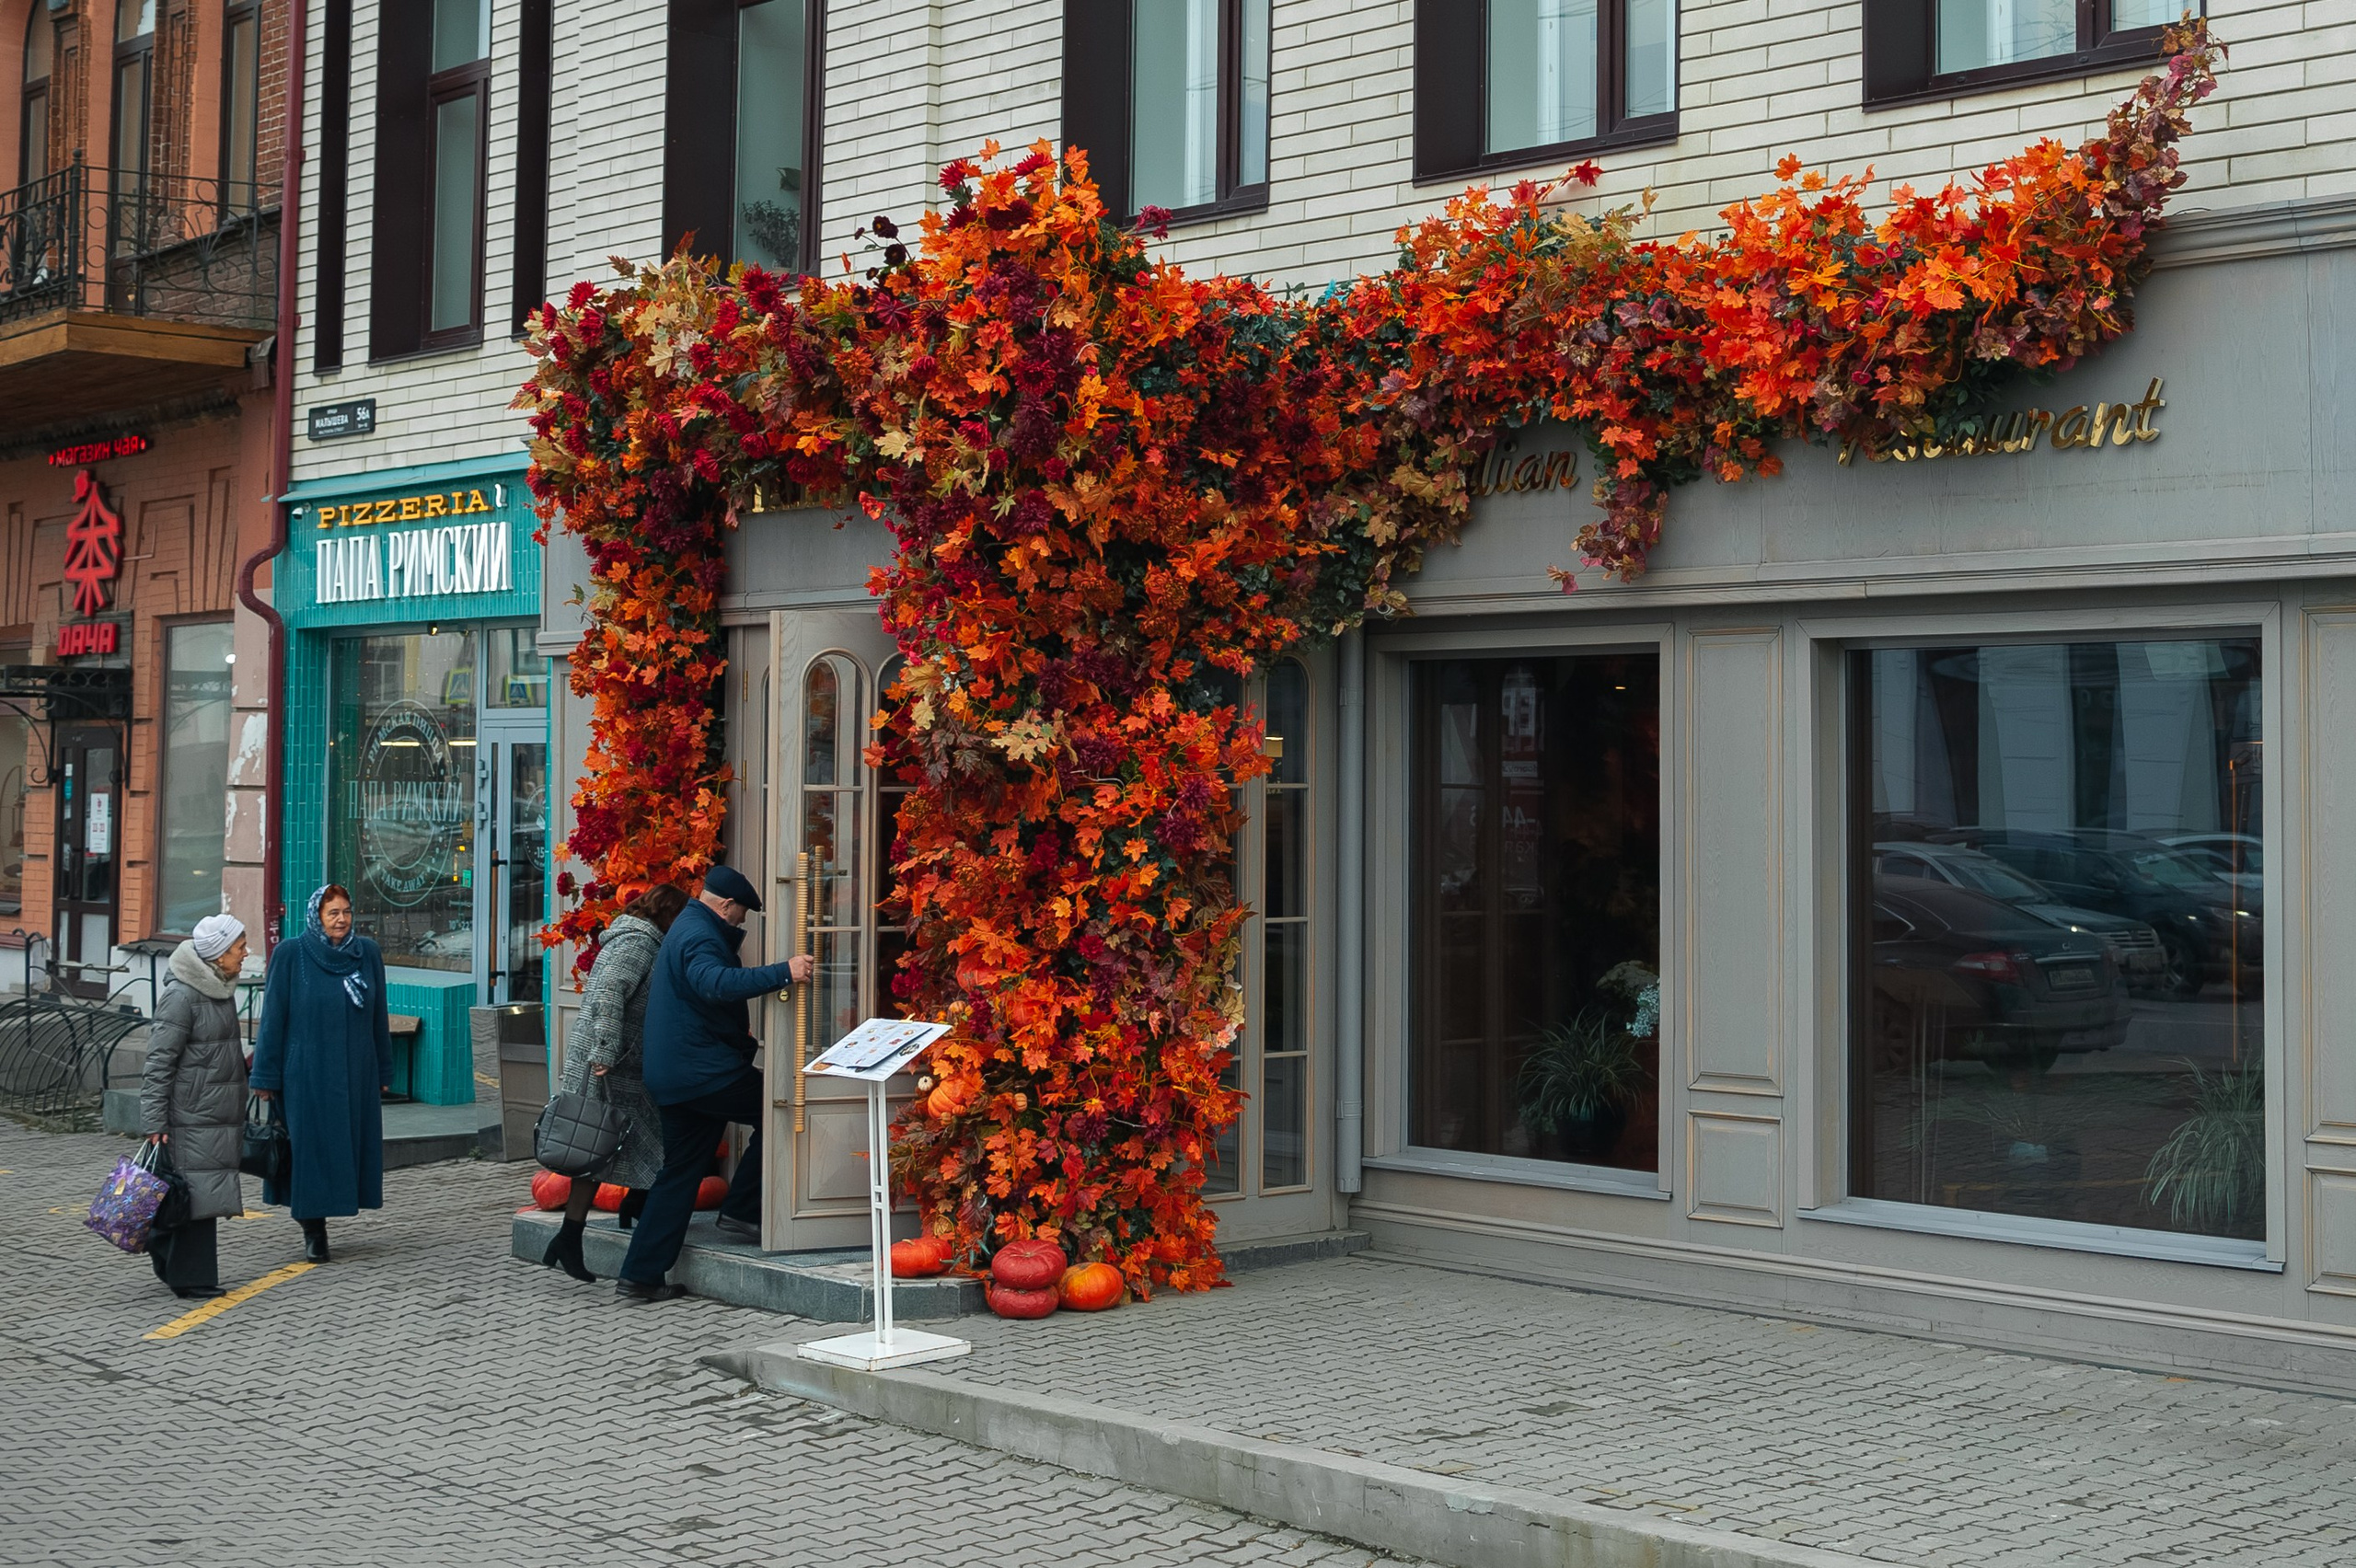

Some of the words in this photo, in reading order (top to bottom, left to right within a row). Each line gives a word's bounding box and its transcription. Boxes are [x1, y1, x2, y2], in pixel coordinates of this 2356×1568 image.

[315, 414, 349, 429] МАЛЫШЕВА
[56, 442, 110, 467] магазин
[113, 435, 139, 457] чая
[1472, 439, 1579, 497] lian
[317, 489, 492, 528] PIZZERIA
[316, 535, 386, 604] ПАПА
[349, 780, 387, 820] ПАПА
[381, 868, 402, 893] TAKE
[403, 871, 426, 893] AWAY
